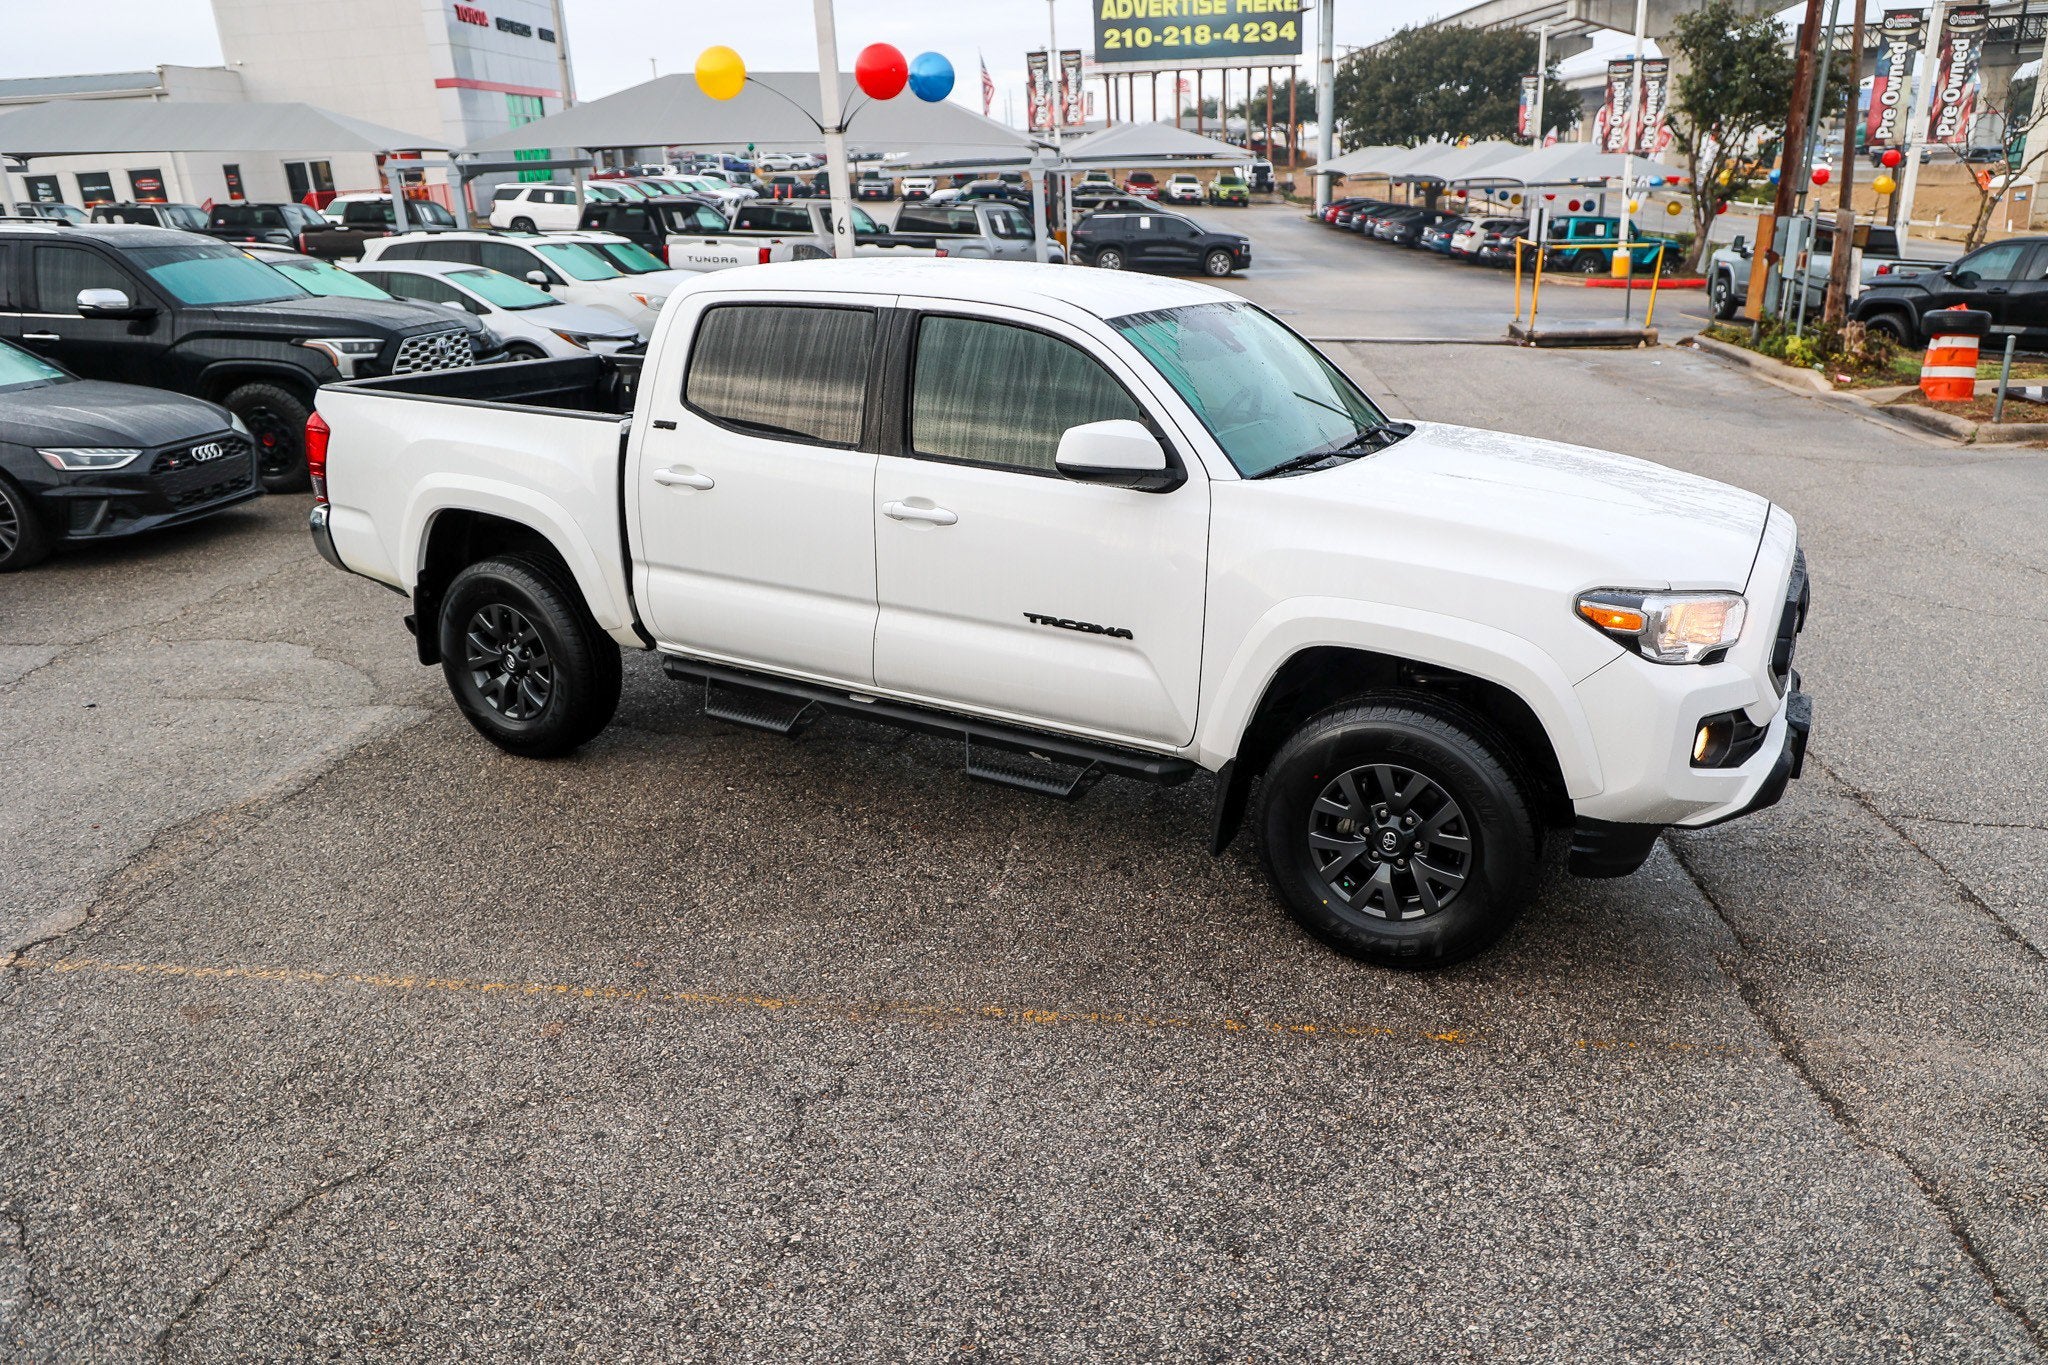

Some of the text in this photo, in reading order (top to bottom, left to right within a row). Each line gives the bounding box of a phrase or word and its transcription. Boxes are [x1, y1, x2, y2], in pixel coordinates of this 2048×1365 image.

[1101, 0, 1227, 20] ADVERTISE
[1103, 20, 1297, 49] 210-218-4234
[1881, 41, 1908, 105] Owned
[1942, 39, 1970, 103] Owned
[1610, 81, 1626, 126] Owned
[1643, 81, 1660, 125] Owned
[1875, 107, 1897, 139] Pre
[1936, 105, 1958, 136] Pre
[1607, 126, 1624, 150] Pre
[1640, 125, 1656, 149] Pre
[837, 217, 845, 235] 6
[687, 255, 738, 264] TUNDRA
[1023, 612, 1133, 640] TACOMA
